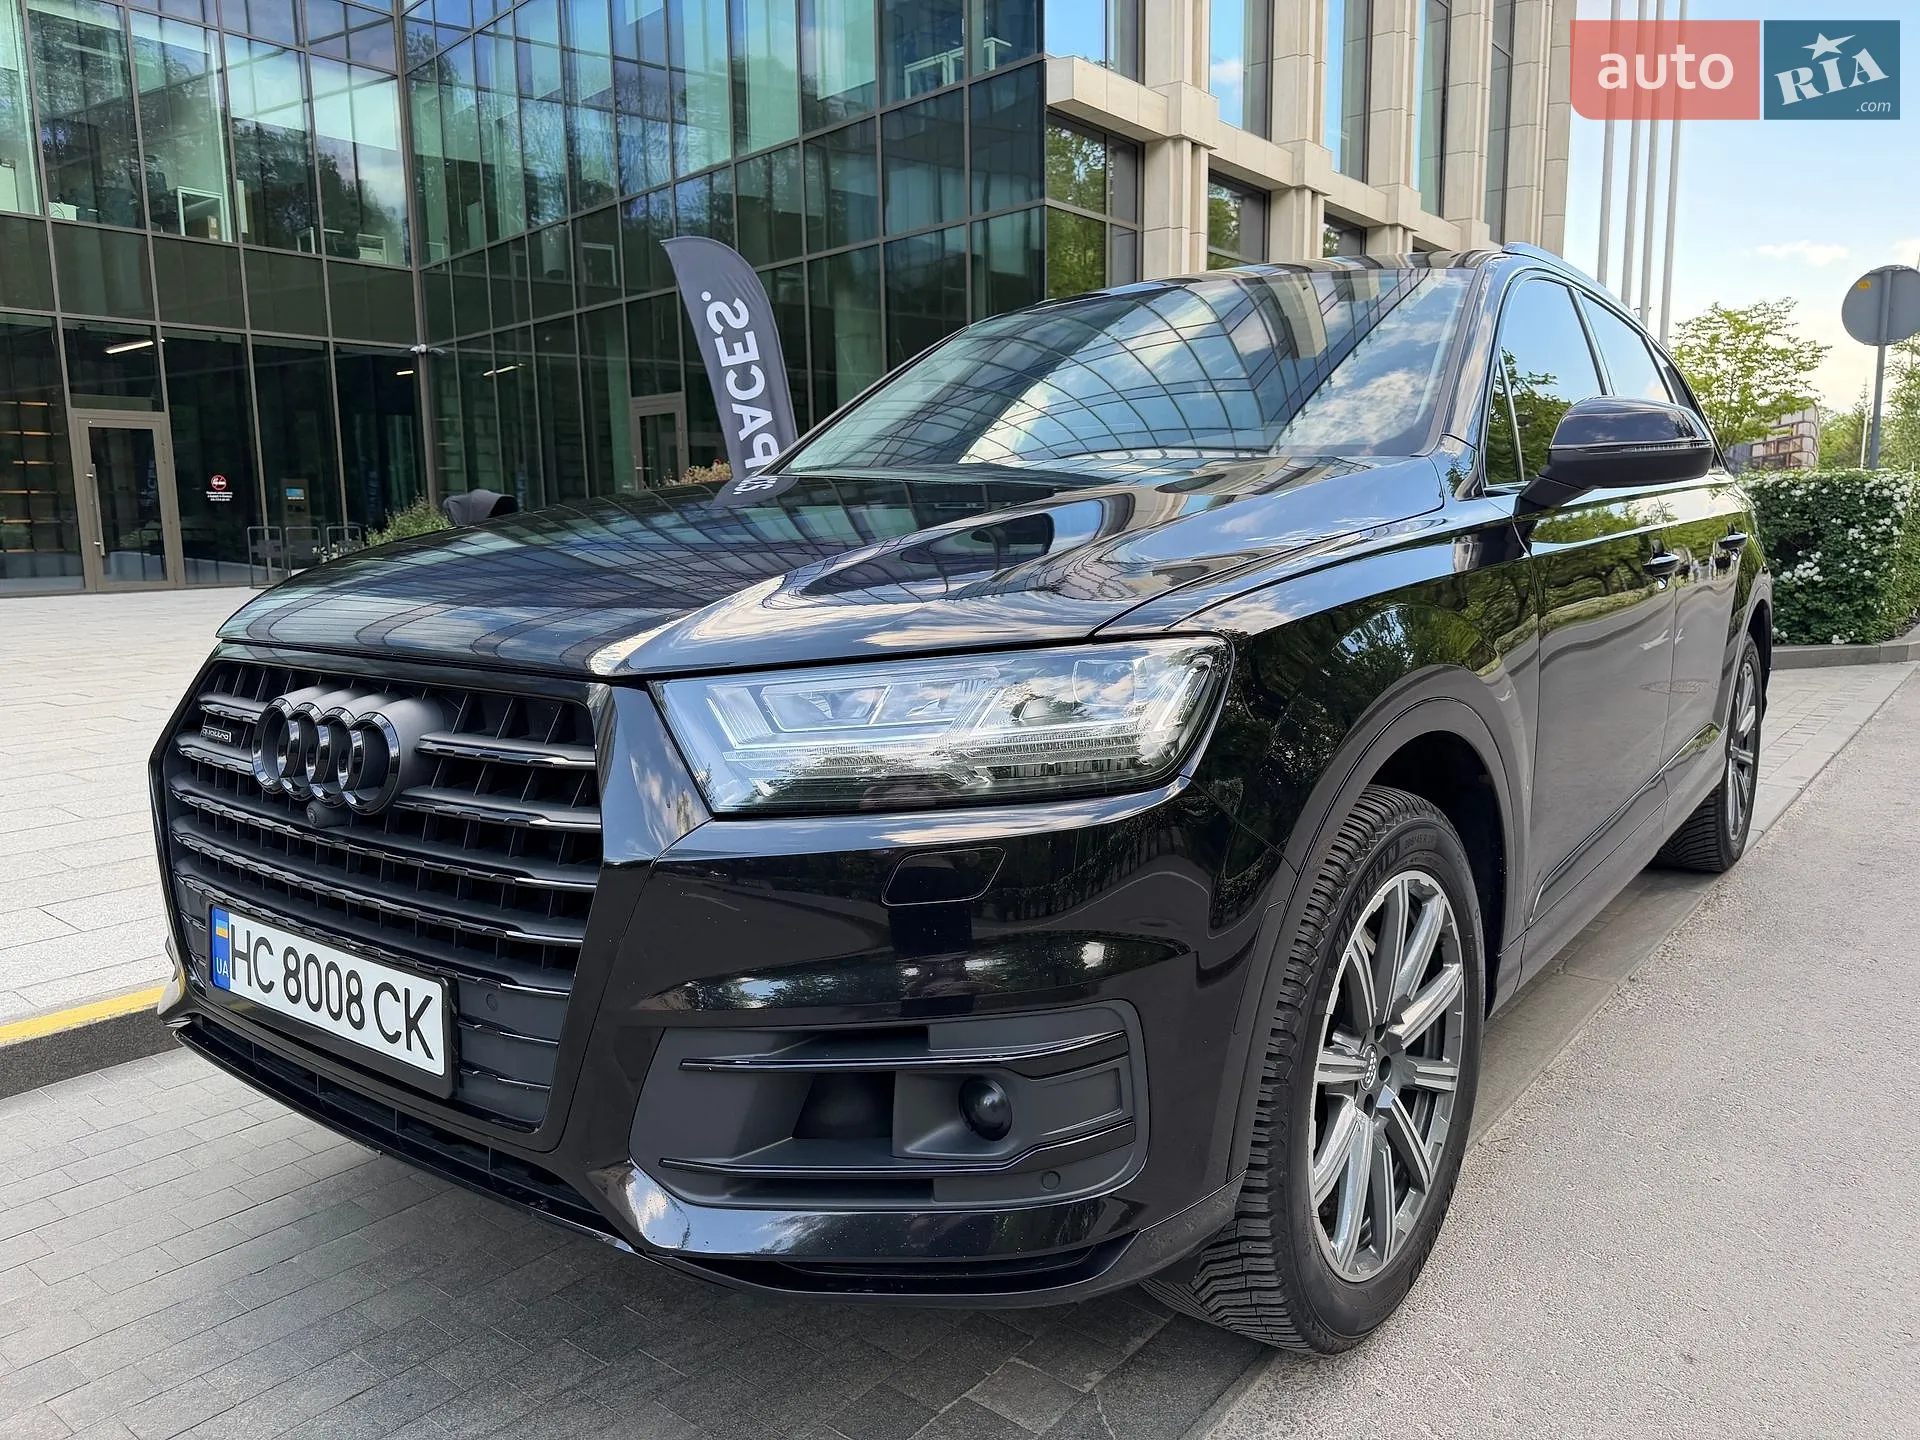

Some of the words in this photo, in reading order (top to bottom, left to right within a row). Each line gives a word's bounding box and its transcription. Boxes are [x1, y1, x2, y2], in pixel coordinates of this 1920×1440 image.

[215, 956, 230, 978] UA
[230, 923, 275, 994] HC
[282, 945, 366, 1031] 8008
[373, 981, 435, 1061] CK
